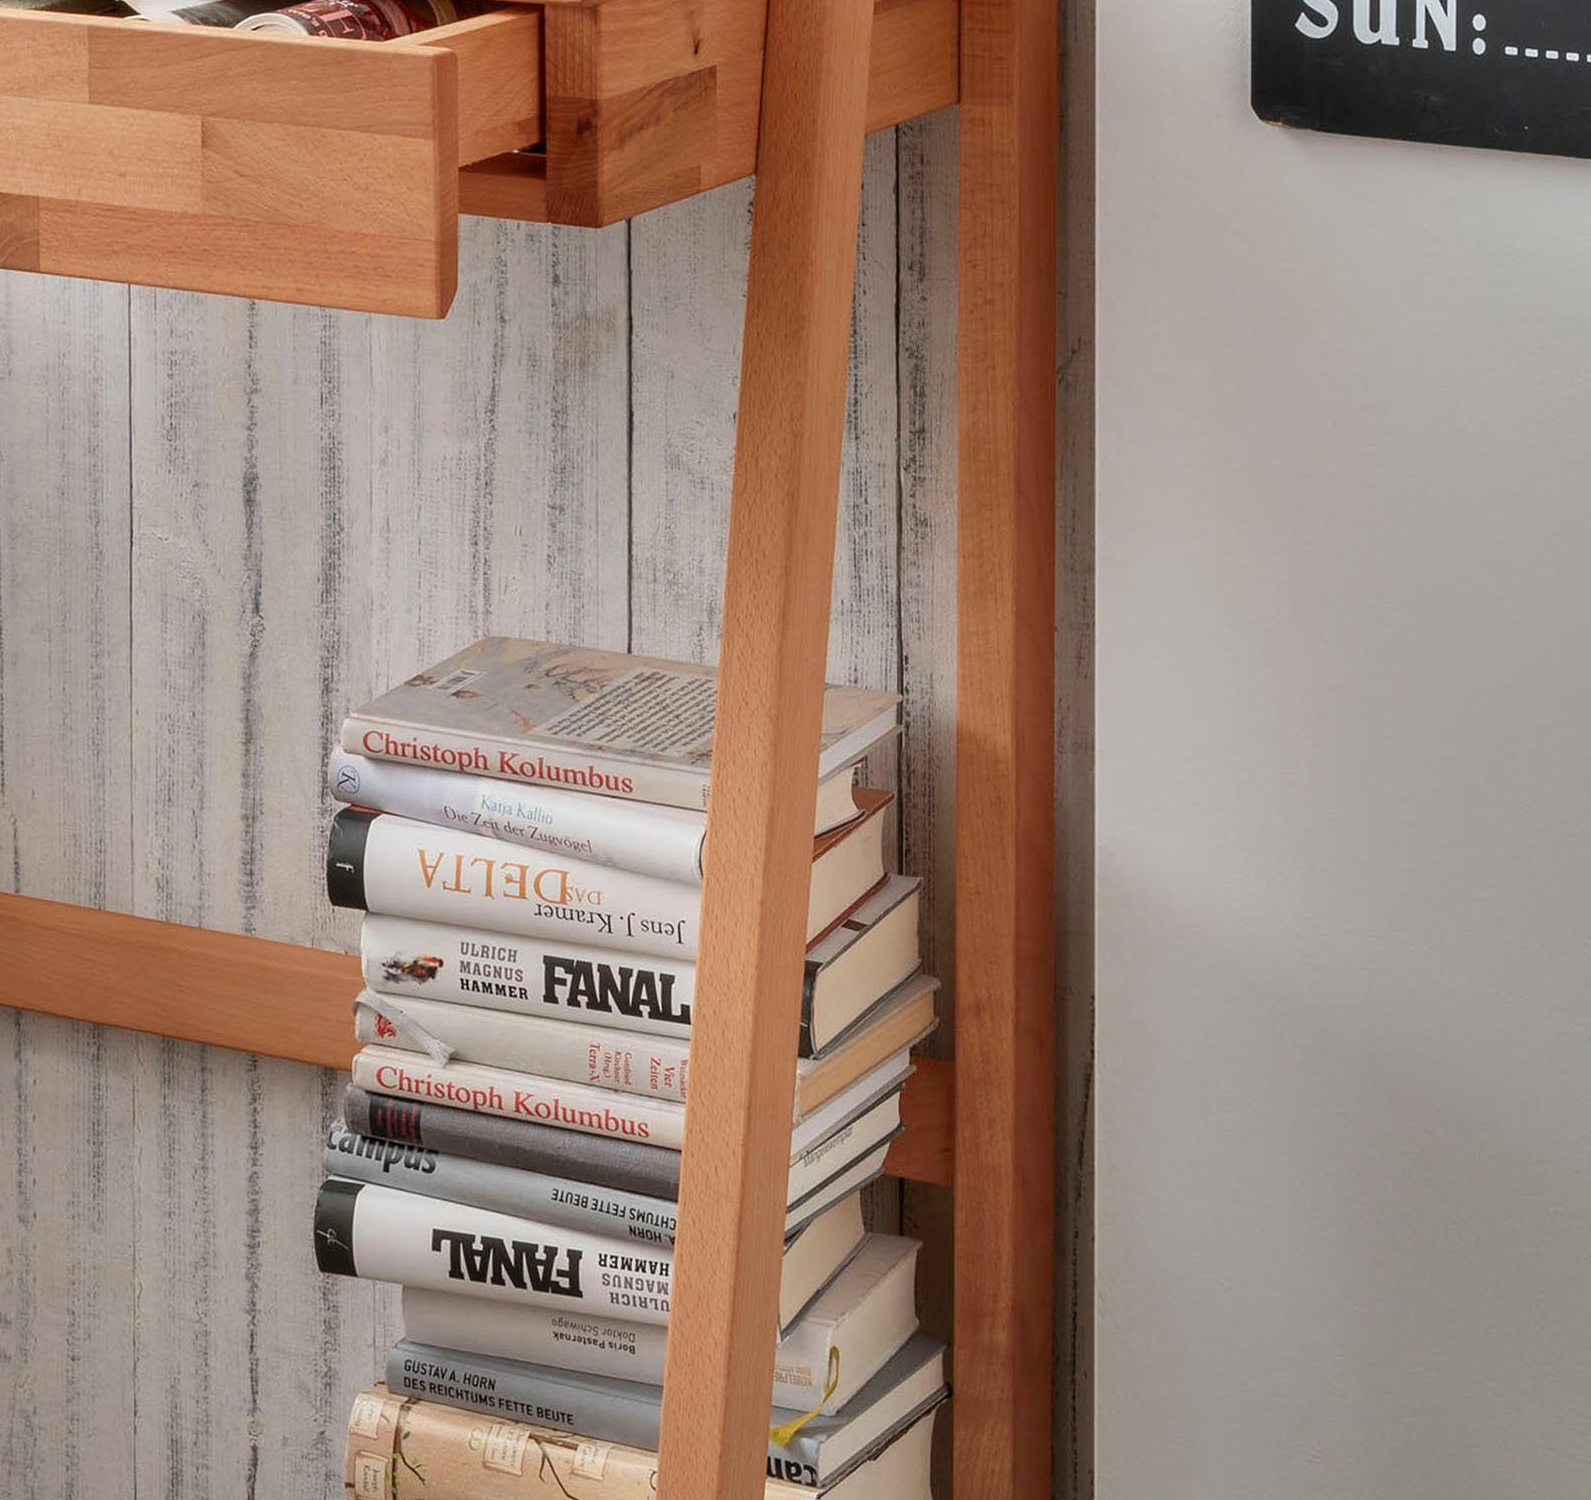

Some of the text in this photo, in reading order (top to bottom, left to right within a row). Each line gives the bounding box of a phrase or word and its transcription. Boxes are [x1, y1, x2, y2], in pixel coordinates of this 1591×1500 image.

[362, 729, 634, 794] Christoph Kolumbus
[443, 805, 469, 824] Die
[471, 811, 501, 833] Zeit
[503, 820, 525, 837] der
[480, 794, 554, 826] Katja Kallio
[417, 848, 602, 906] DAS DELTA
[533, 904, 686, 944] Jens J. Kramer
[460, 941, 518, 963] ULRICH
[459, 962, 524, 983] MAGNUS
[460, 979, 528, 1000] HAMMER
[542, 954, 692, 1025] FANAL
[375, 1065, 650, 1138] Christoph Kolumbus
[326, 1123, 438, 1174] campus
[550, 1188, 589, 1208] BEUTE
[591, 1198, 627, 1218] FETTE
[628, 1225, 662, 1243] HORN
[432, 1228, 583, 1298] FANAL
[598, 1253, 669, 1276] HAMMER
[602, 1273, 668, 1295] MAGNUS
[609, 1292, 669, 1312] ULRICH
[551, 1317, 636, 1343] Doktor Schiwago
[552, 1331, 636, 1355] Boris Pasternak
[403, 1358, 497, 1391] GUSTAV A. HORN
[403, 1376, 575, 1426] DES REICHTUMS FETTE BEUTE
